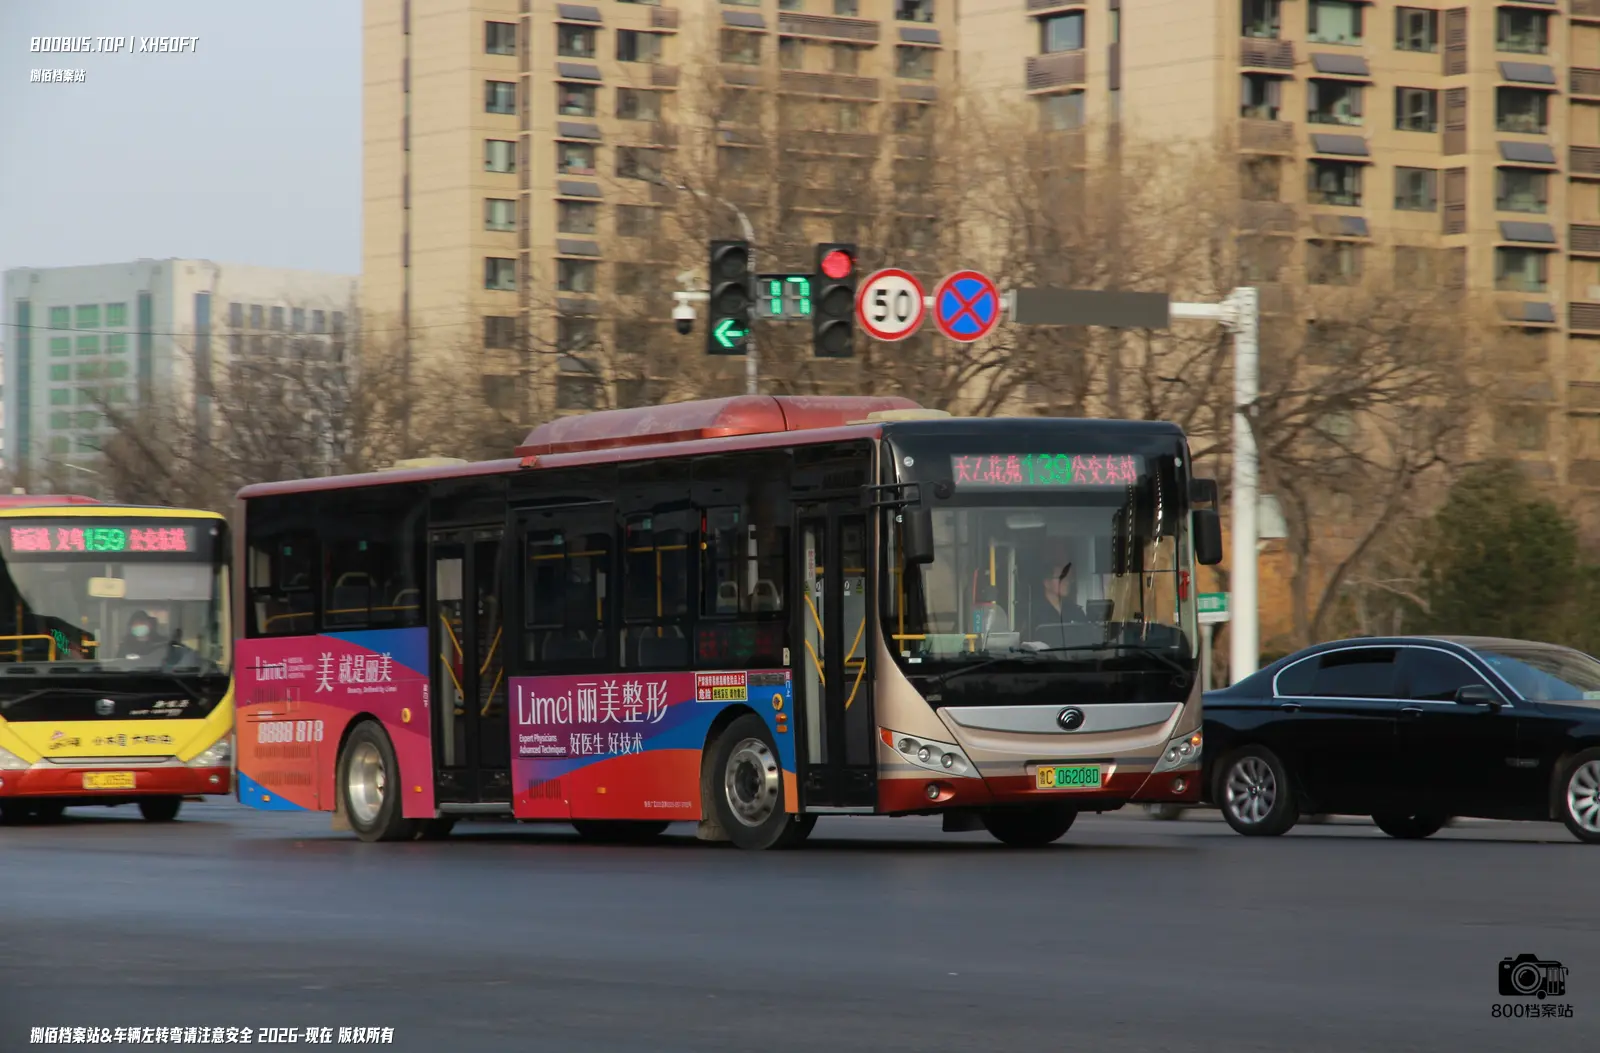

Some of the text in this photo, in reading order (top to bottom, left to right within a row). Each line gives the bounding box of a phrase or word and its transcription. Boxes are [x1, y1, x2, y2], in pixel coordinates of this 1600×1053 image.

[770, 277, 810, 315] 17
[874, 289, 912, 323] 50
[1022, 453, 1071, 485] 139
[1071, 455, 1137, 485] 公交东站
[82, 528, 126, 552] 159
[255, 656, 287, 681] Limei
[517, 680, 668, 725] Limei 丽美整形
[698, 688, 712, 700] 危险
[296, 720, 323, 742] 818
[519, 733, 557, 744] Expert Physicians
[520, 743, 567, 756] Advanced Techniques
[570, 732, 643, 755] 好医生 好技术
